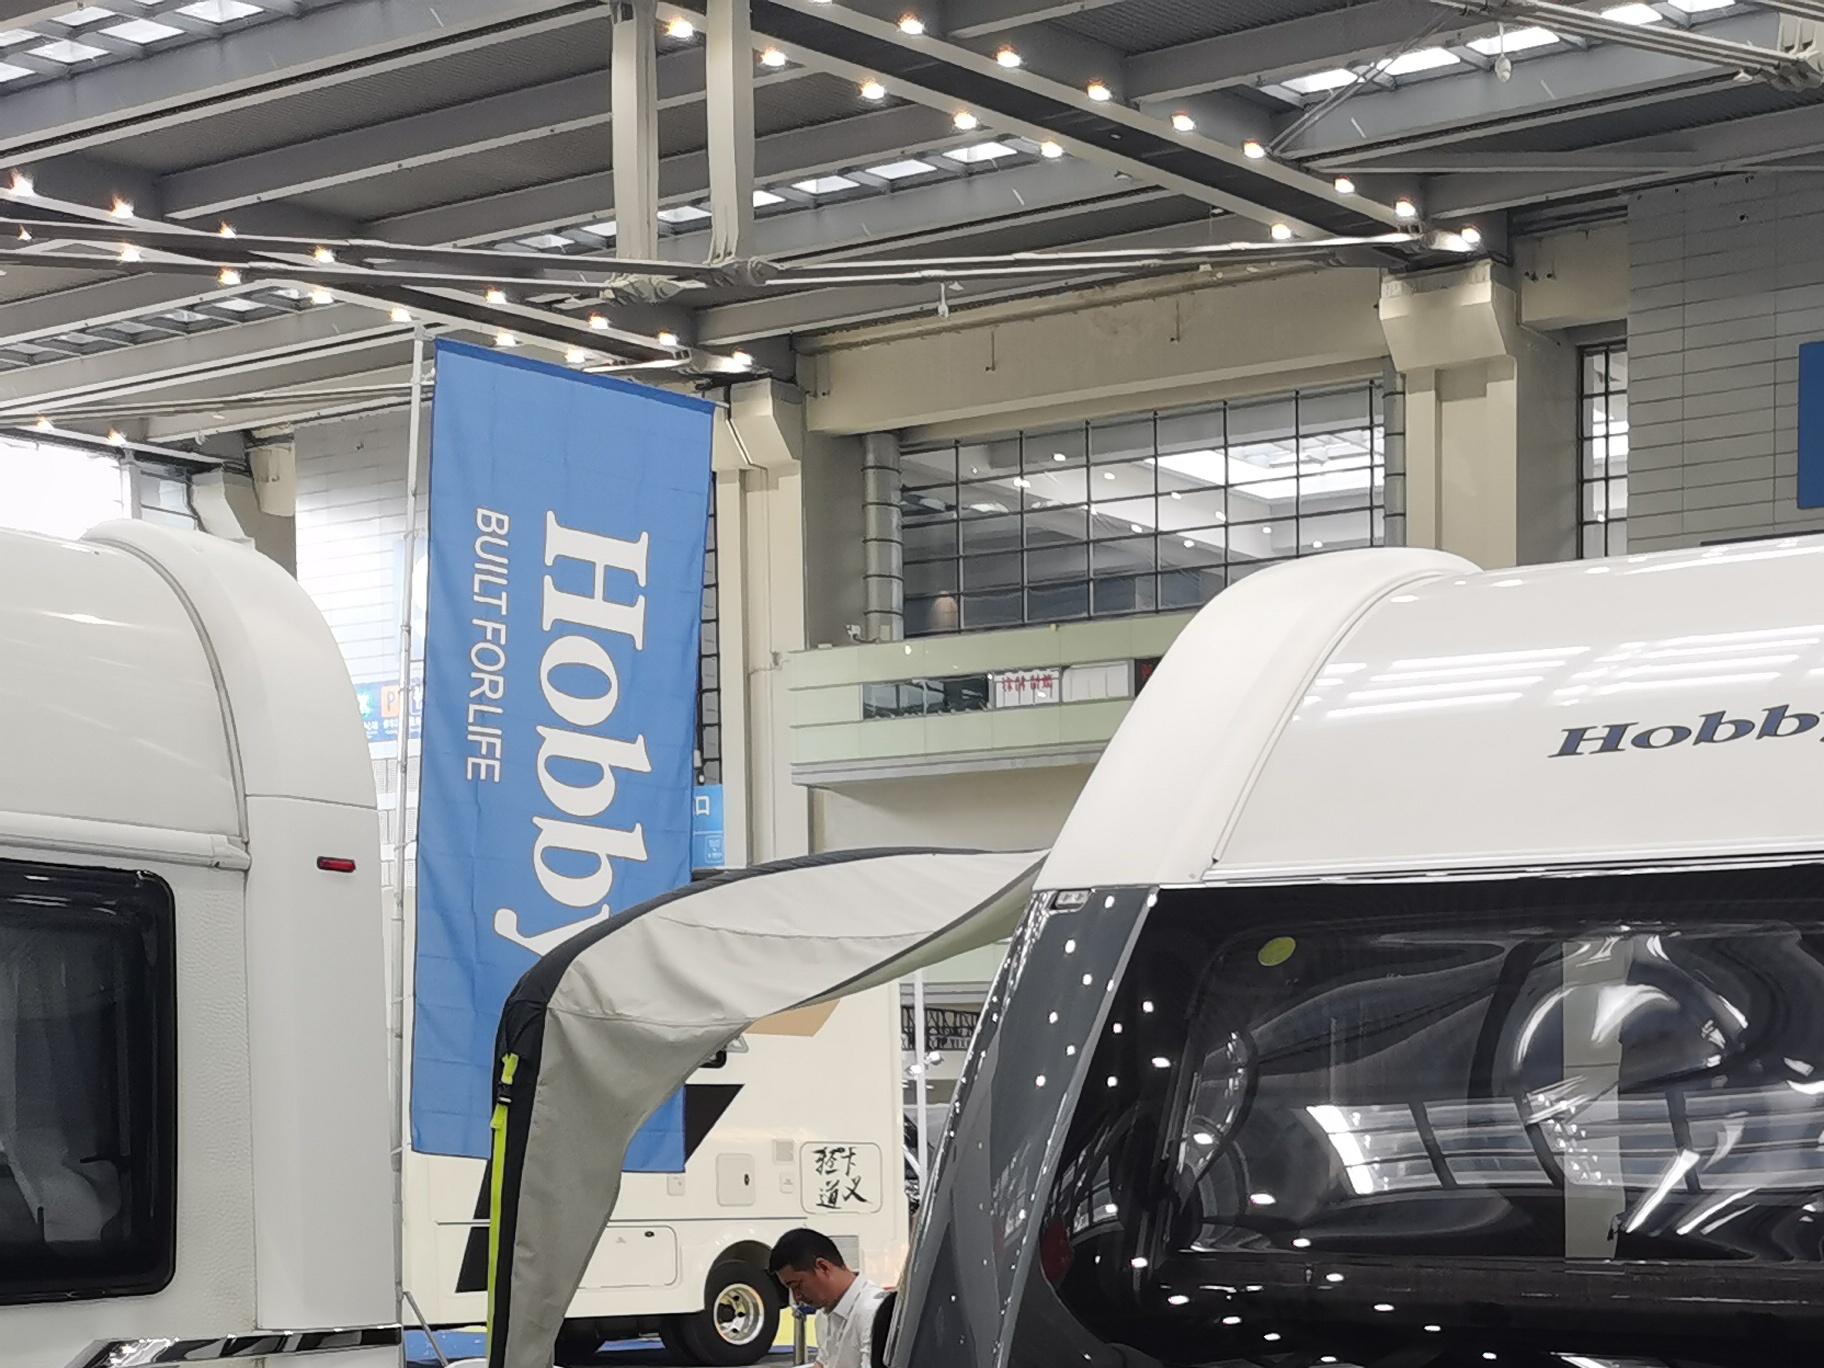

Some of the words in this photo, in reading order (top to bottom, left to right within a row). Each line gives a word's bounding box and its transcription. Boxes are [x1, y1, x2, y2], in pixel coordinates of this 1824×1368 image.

[472, 506, 511, 617] BUILT
[468, 617, 507, 700] FOR
[465, 702, 505, 784] LIFE
[494, 509, 652, 958] Hobby
